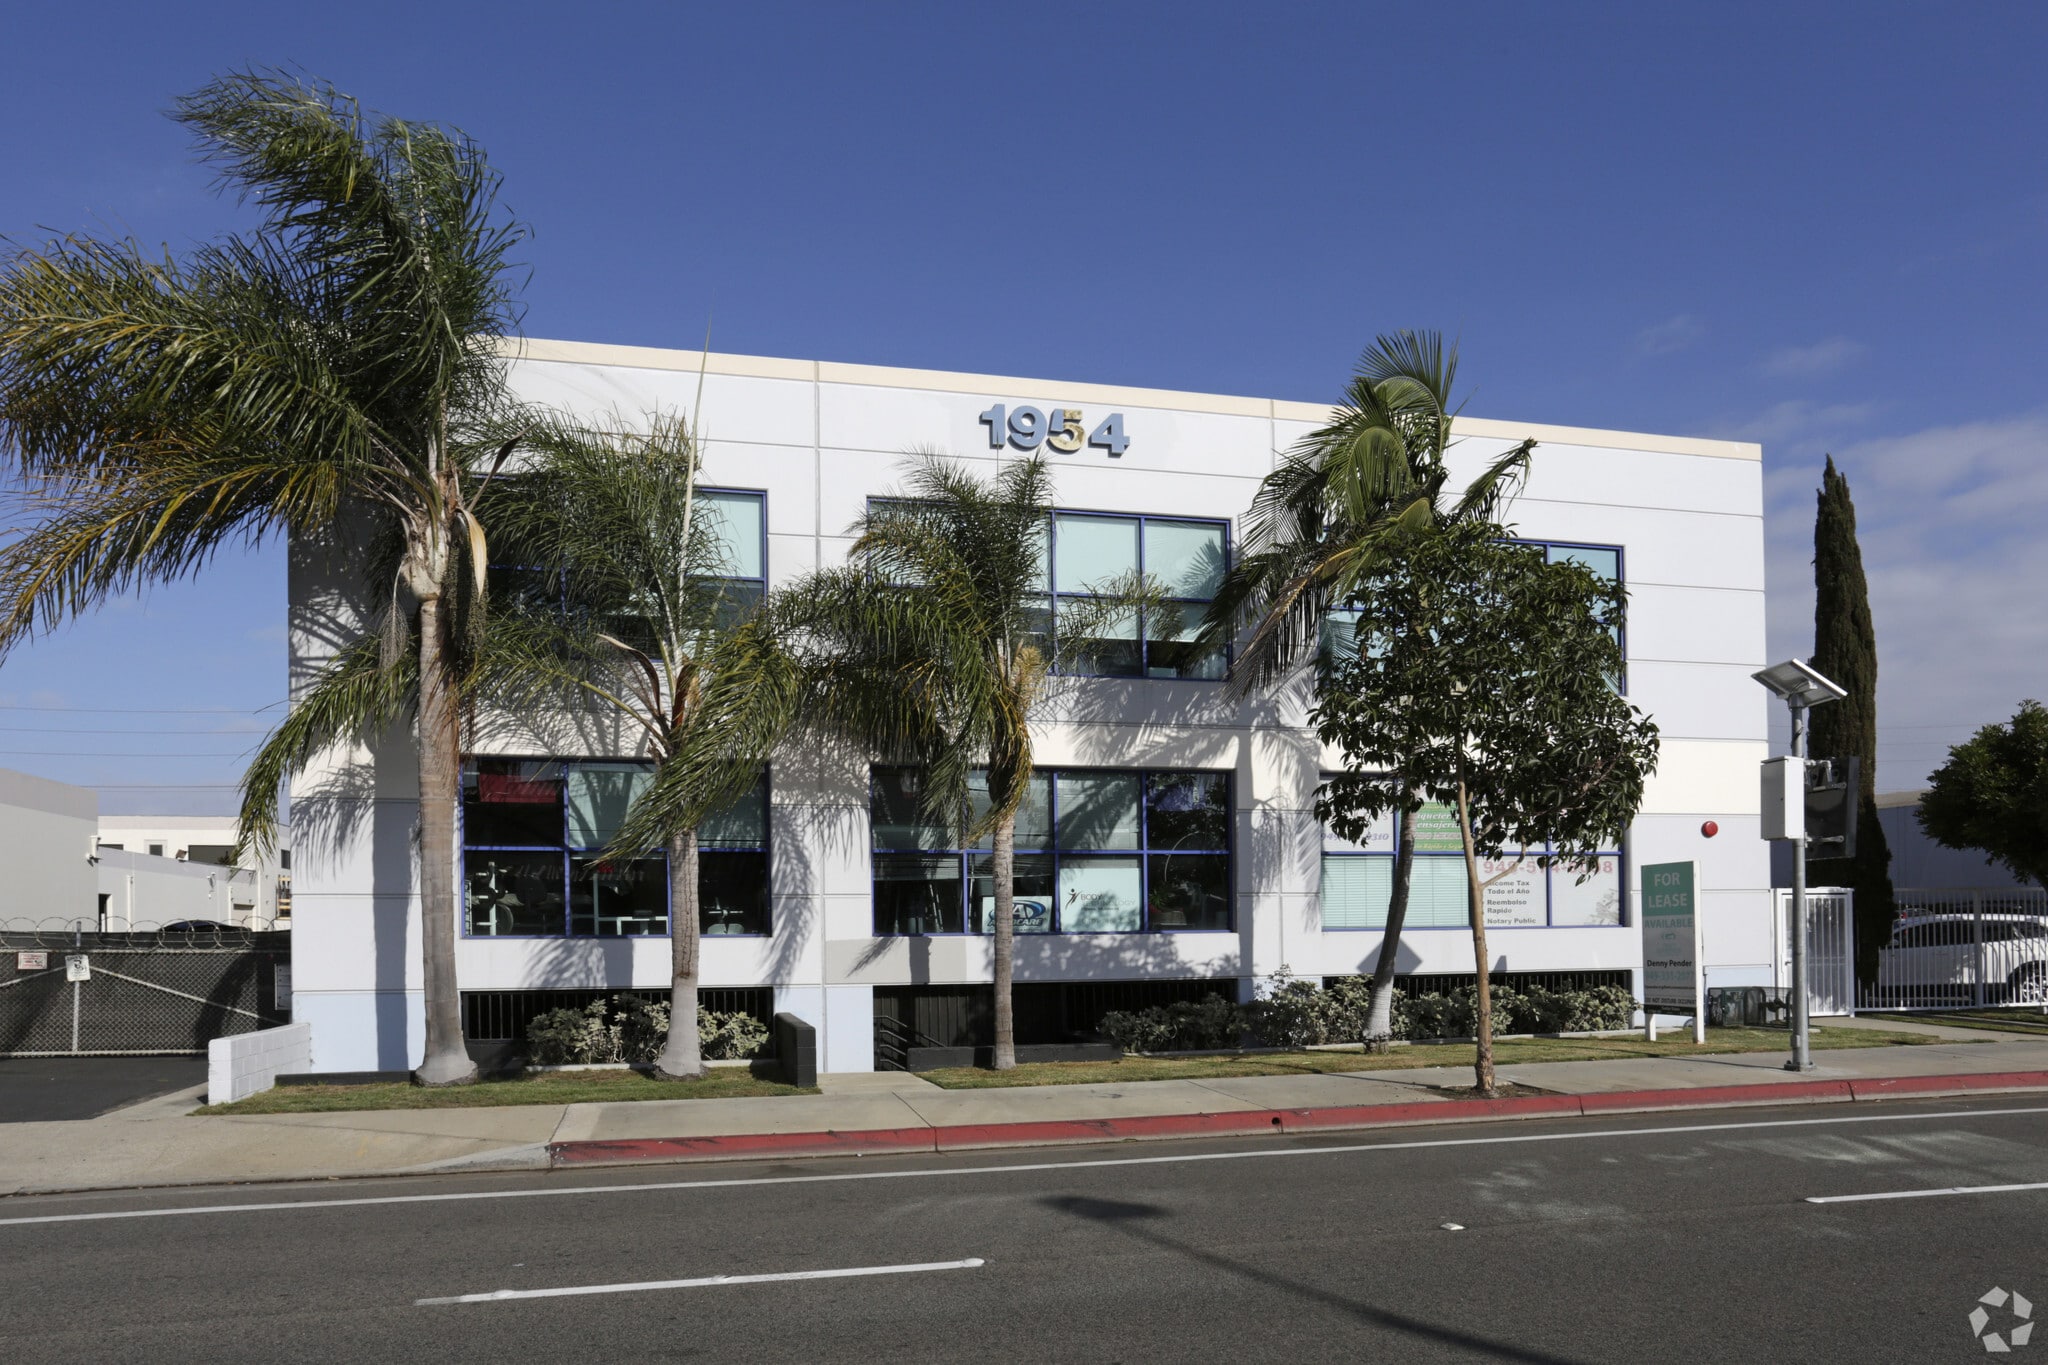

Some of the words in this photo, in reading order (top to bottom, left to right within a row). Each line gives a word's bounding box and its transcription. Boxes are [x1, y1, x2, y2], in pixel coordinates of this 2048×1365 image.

[980, 403, 1130, 457] 1954
[1654, 872, 1680, 886] FOR
[1648, 893, 1688, 908] LEASE
[1644, 917, 1693, 928] AVAILABLE
[1647, 960, 1668, 968] Denny
